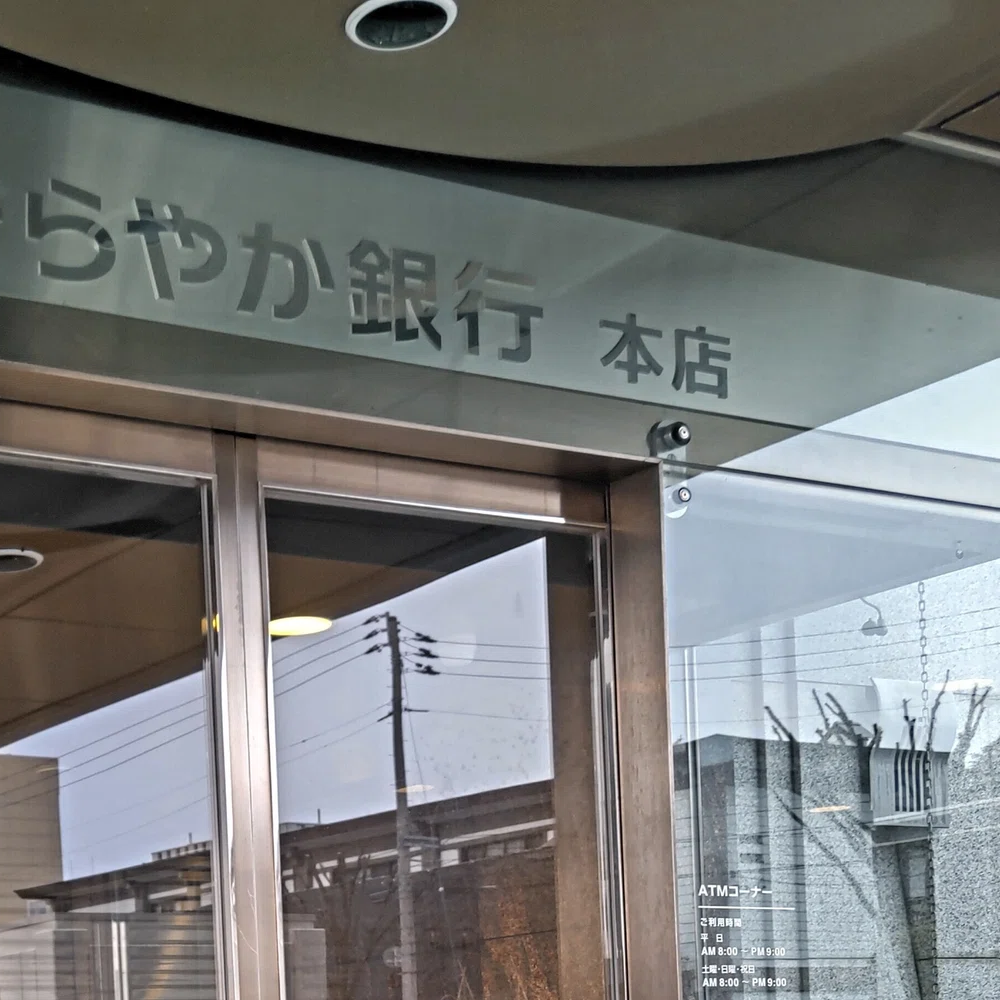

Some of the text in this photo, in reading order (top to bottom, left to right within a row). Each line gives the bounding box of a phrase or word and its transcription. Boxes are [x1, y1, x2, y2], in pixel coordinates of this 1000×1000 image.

[599, 312, 733, 400] 本店
[698, 884, 772, 897] ATMコーナー
[700, 917, 742, 928] ご利用時間
